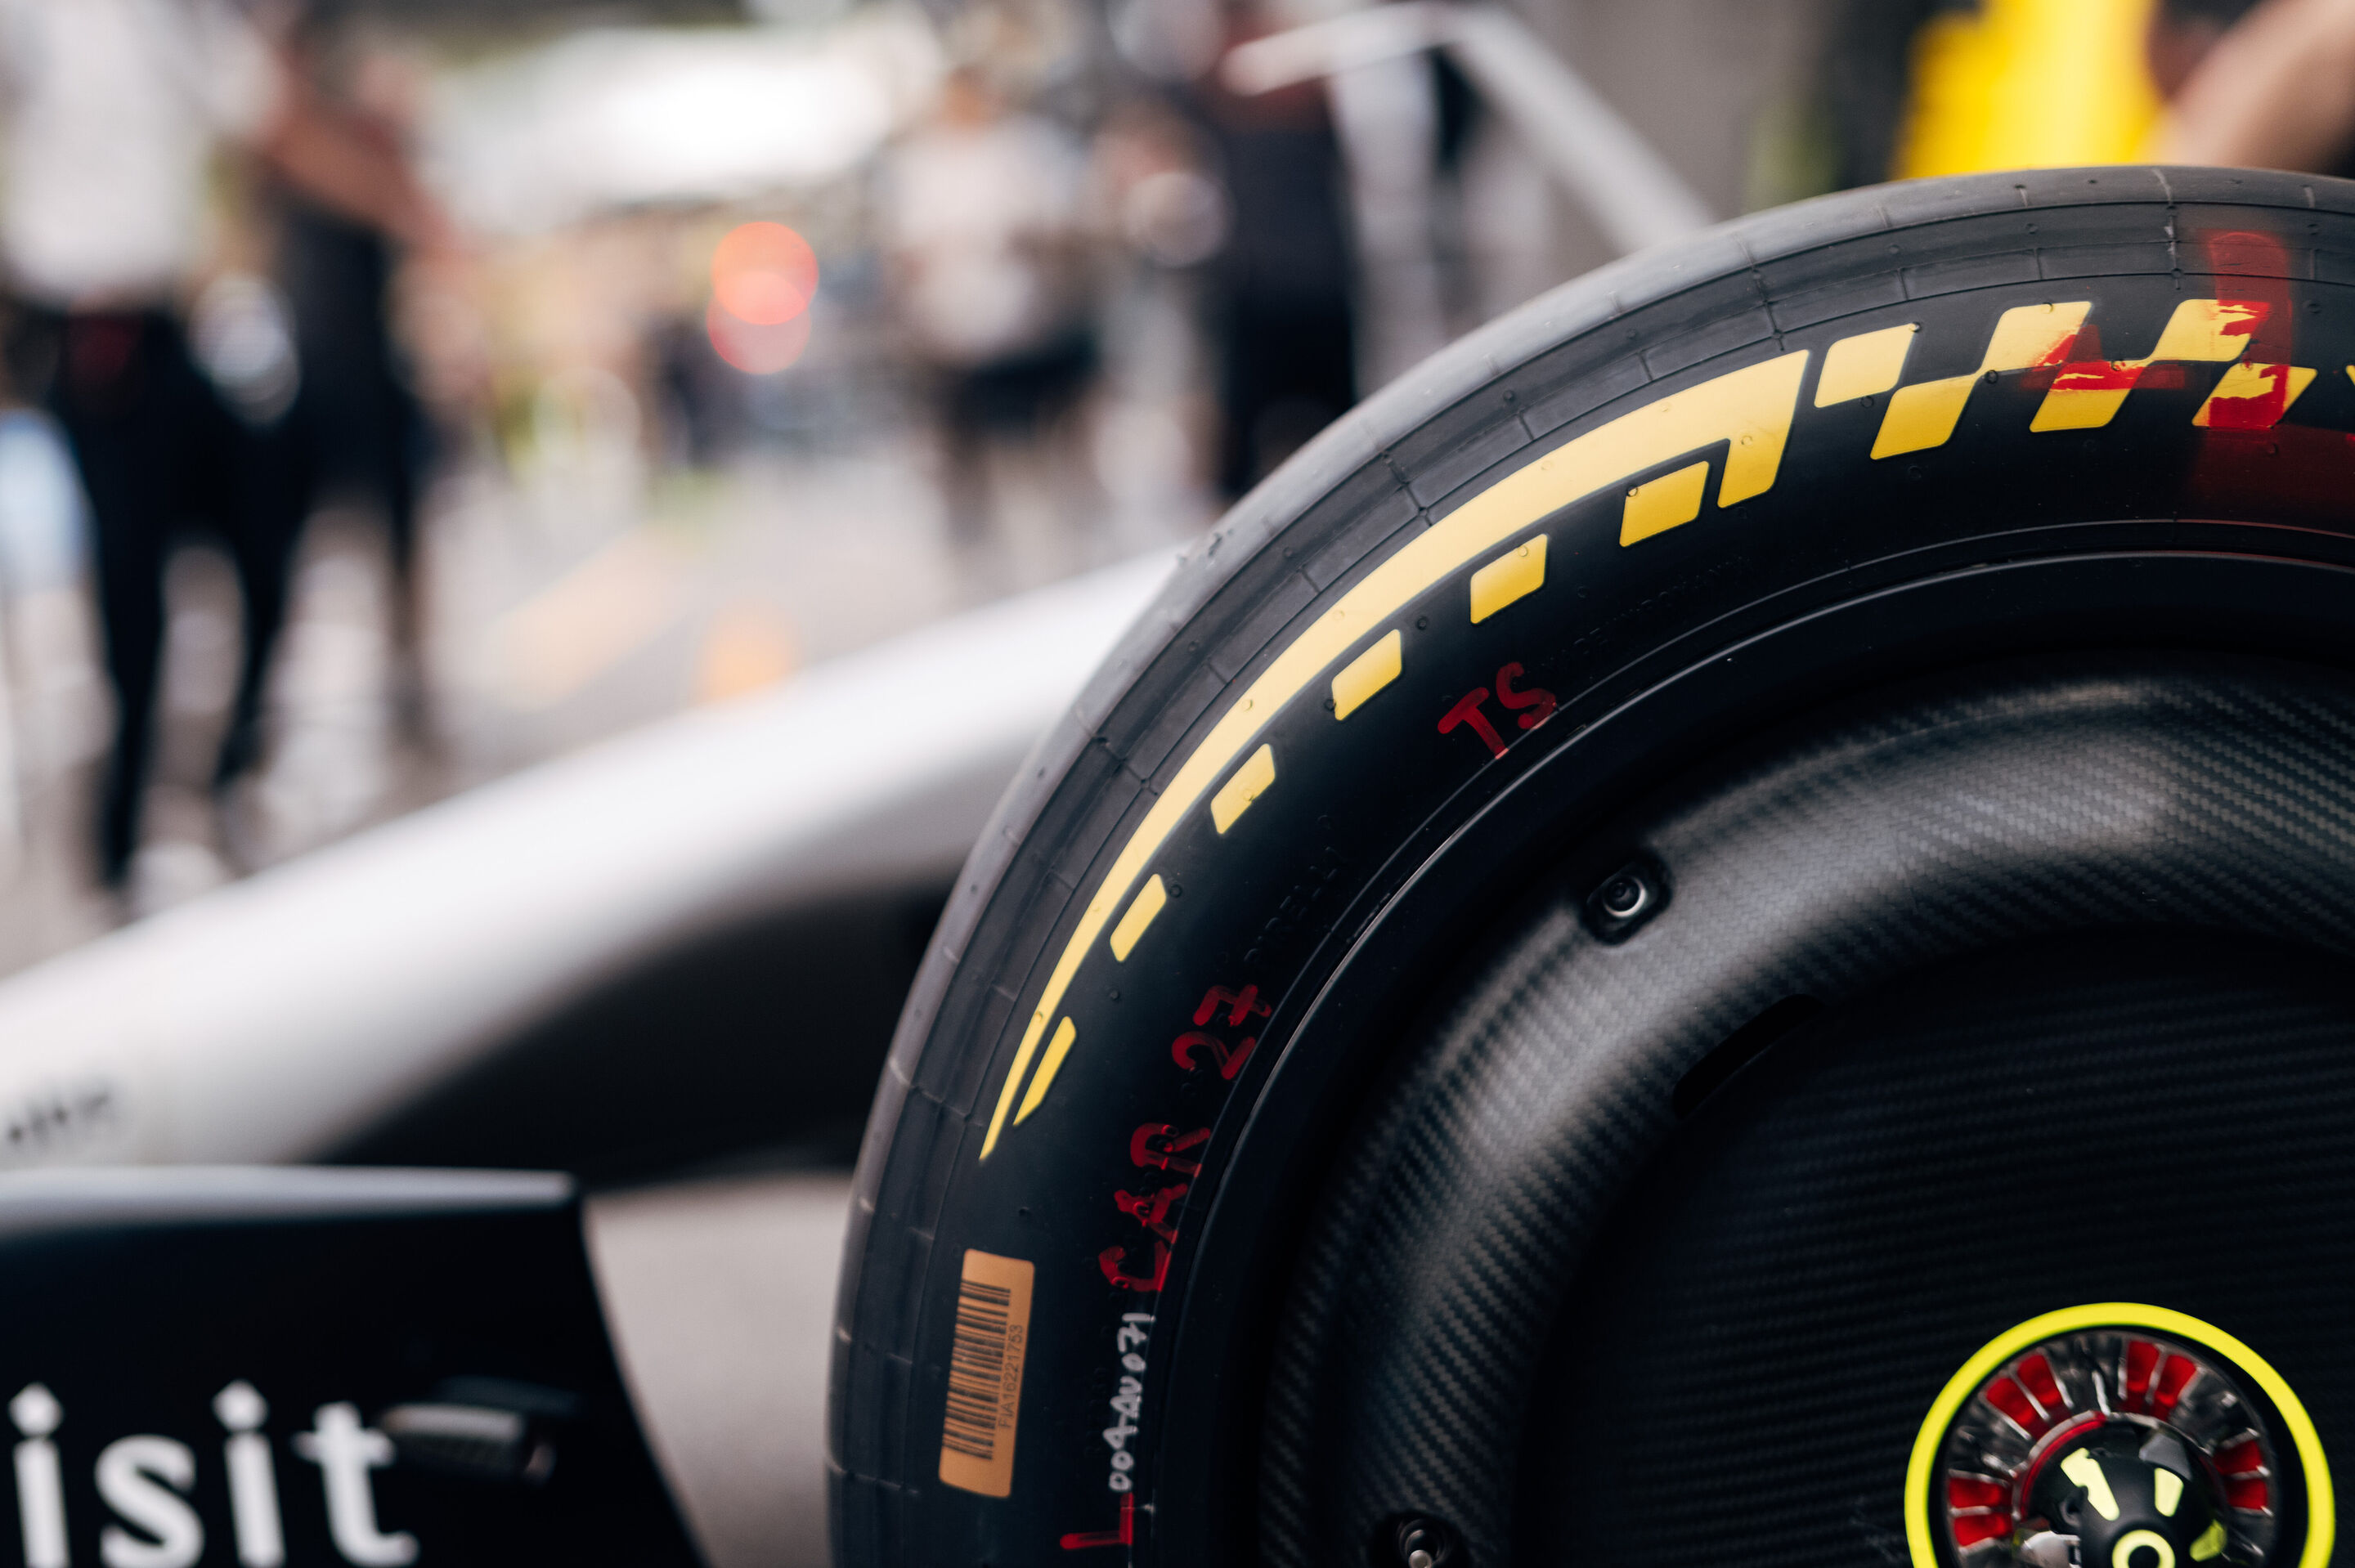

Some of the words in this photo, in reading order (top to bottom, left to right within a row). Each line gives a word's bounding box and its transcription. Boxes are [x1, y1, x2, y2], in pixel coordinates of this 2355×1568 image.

[1438, 663, 1557, 759] TS
[1099, 1125, 1212, 1292] CAR
[1173, 985, 1272, 1080] 27
[997, 1323, 1024, 1429] FIA16221753
